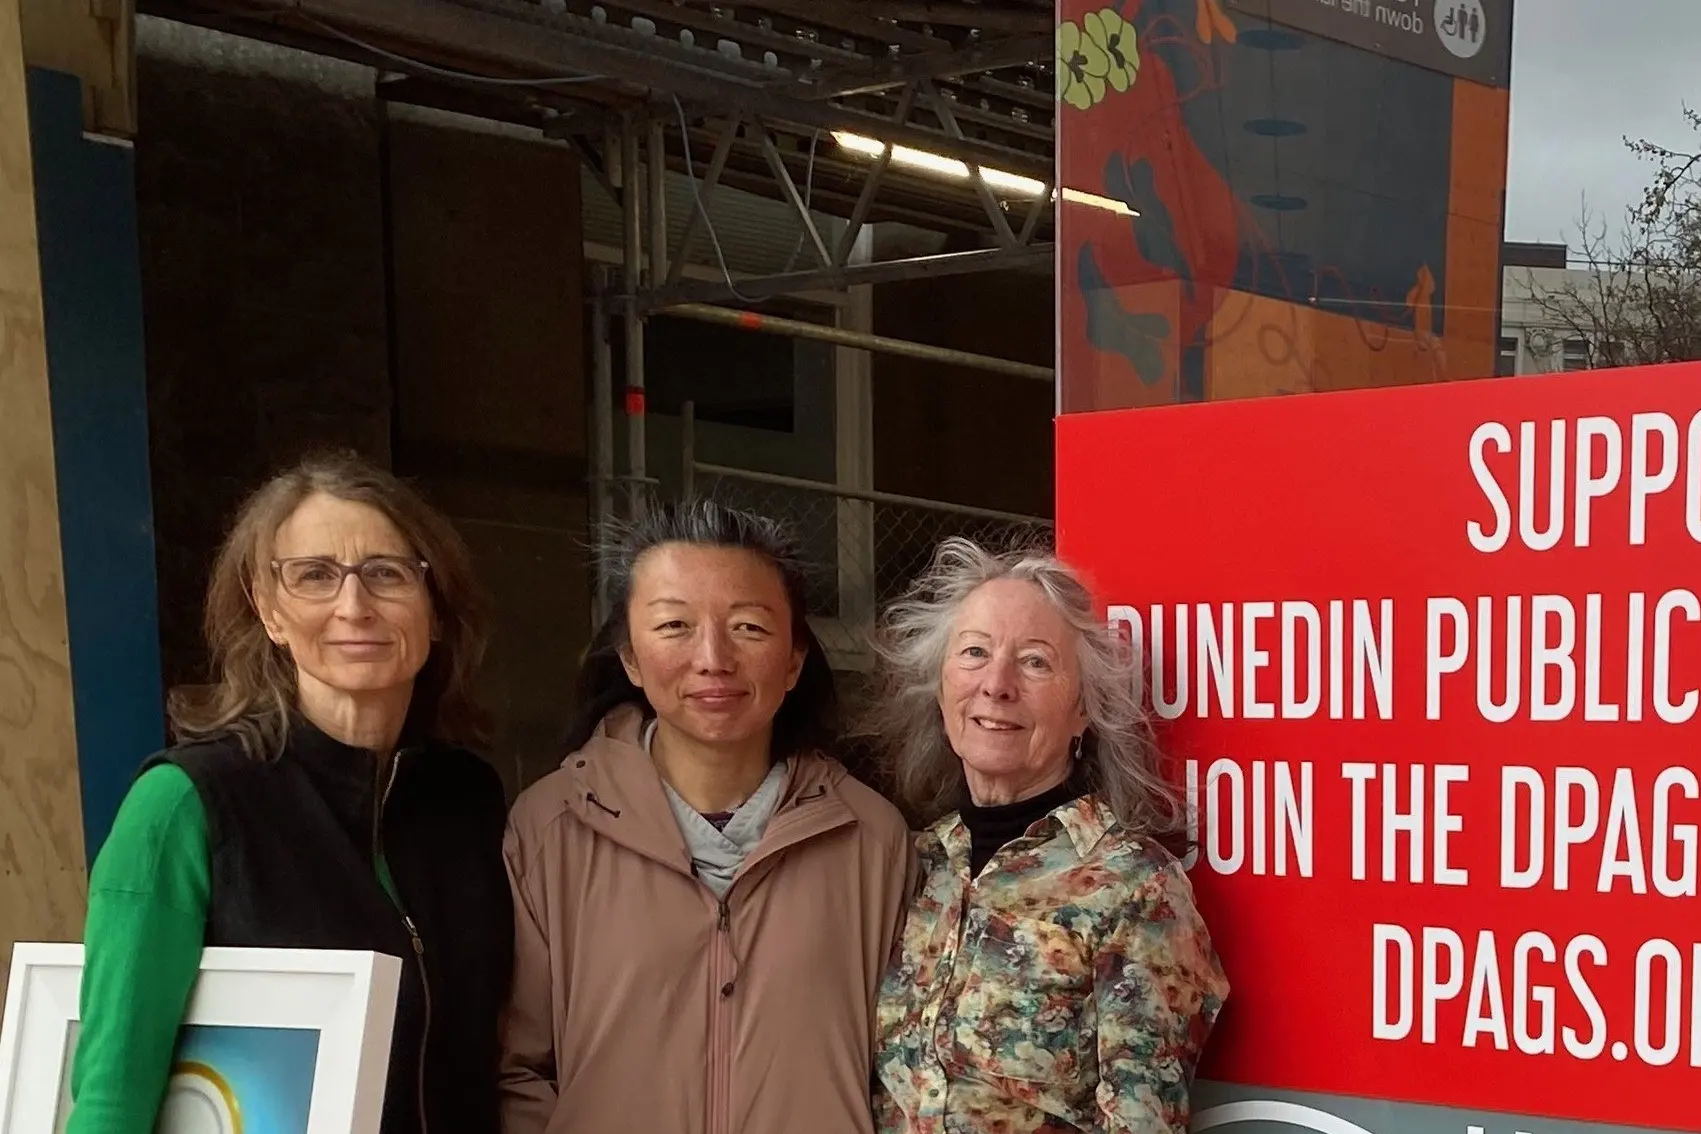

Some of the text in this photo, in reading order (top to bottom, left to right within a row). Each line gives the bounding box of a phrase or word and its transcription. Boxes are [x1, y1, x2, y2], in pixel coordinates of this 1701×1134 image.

[1107, 598, 1394, 719] DUNEDIN
[1426, 588, 1701, 724] PUBLIC
[1179, 757, 1314, 878] JOIN
[1341, 762, 1470, 887] THE
[1501, 764, 1700, 898] DPAG
